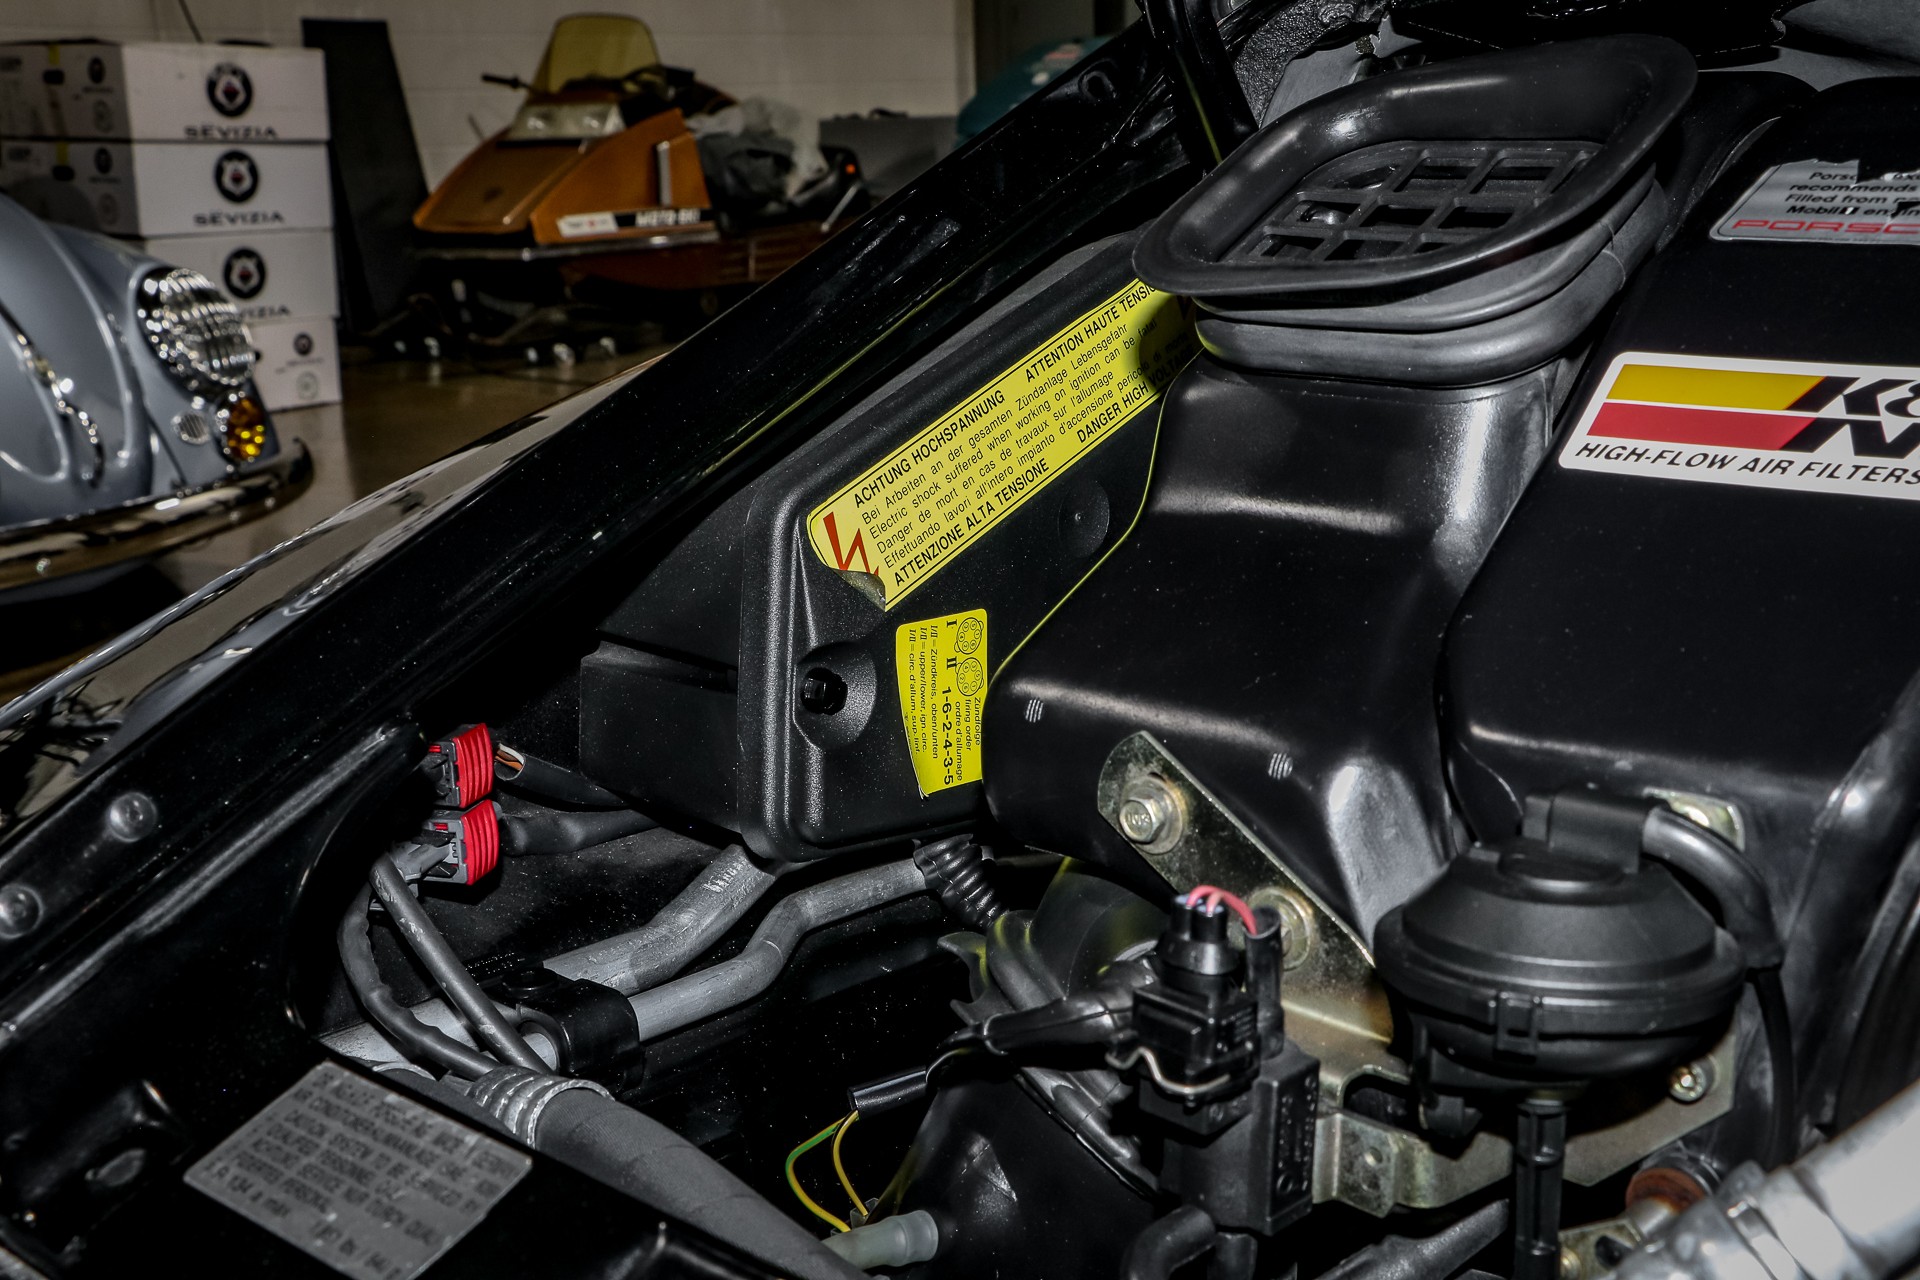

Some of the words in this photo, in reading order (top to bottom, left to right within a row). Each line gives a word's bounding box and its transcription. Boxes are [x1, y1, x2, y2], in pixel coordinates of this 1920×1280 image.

[1785, 194, 1838, 203] Filled
[1840, 194, 1887, 204] from
[1786, 206, 1840, 214] Mobil
[1790, 184, 1918, 192] recommends
[1026, 332, 1084, 382] ATTENTION
[1084, 306, 1120, 338] HAUTE
[855, 459, 911, 508] ACHTUNG
[911, 390, 1005, 464] HOCHSPANNUNG
[862, 505, 880, 524] Bei
[886, 474, 926, 508] Arbeiten
[931, 461, 943, 474] an
[948, 445, 963, 461] der
[969, 410, 1012, 449] gesamten
[1016, 369, 1067, 411] Zündanlage
[1071, 324, 1127, 370] Lebensgefahr
[870, 508, 907, 539] Electric
[912, 482, 941, 508] shock
[945, 448, 983, 483] suffered
[987, 429, 1012, 451] when
[1016, 401, 1051, 429] working
[1055, 389, 1066, 401] on
[1069, 363, 1101, 390] ignition
[1105, 348, 1120, 363] can
[1123, 335, 1136, 350] be
[1138, 318, 1157, 338] fatal
[1077, 403, 1121, 443] DANGER
[1122, 379, 1150, 408] HIGH
[877, 522, 913, 553] Danger
[919, 510, 931, 523] de
[936, 488, 958, 510] mort
[963, 477, 975, 489] en
[979, 461, 995, 477] cas
[1000, 448, 1012, 461] de
[1016, 420, 1049, 448] travaux
[1053, 406, 1066, 421] sur
[1071, 372, 1113, 407] l'allumage
[884, 523, 940, 568] Effettuando
[944, 496, 971, 522] lavori
[976, 466, 1013, 499] all'intero
[1017, 434, 1055, 466] impianto
[1059, 390, 1113, 434] d'accensione
[1117, 362, 1151, 393] pericolo
[1575, 443, 1739, 470] HIGH-FLOW
[1738, 458, 1795, 475] AIR
[1798, 462, 1920, 485] FILTERS
[895, 524, 964, 586] ATTENZIONE
[966, 501, 995, 530] ALTA
[995, 458, 1049, 505] TENSIONE
[947, 656, 957, 670] II
[942, 686, 954, 785] 1-6-2-4-3-5
